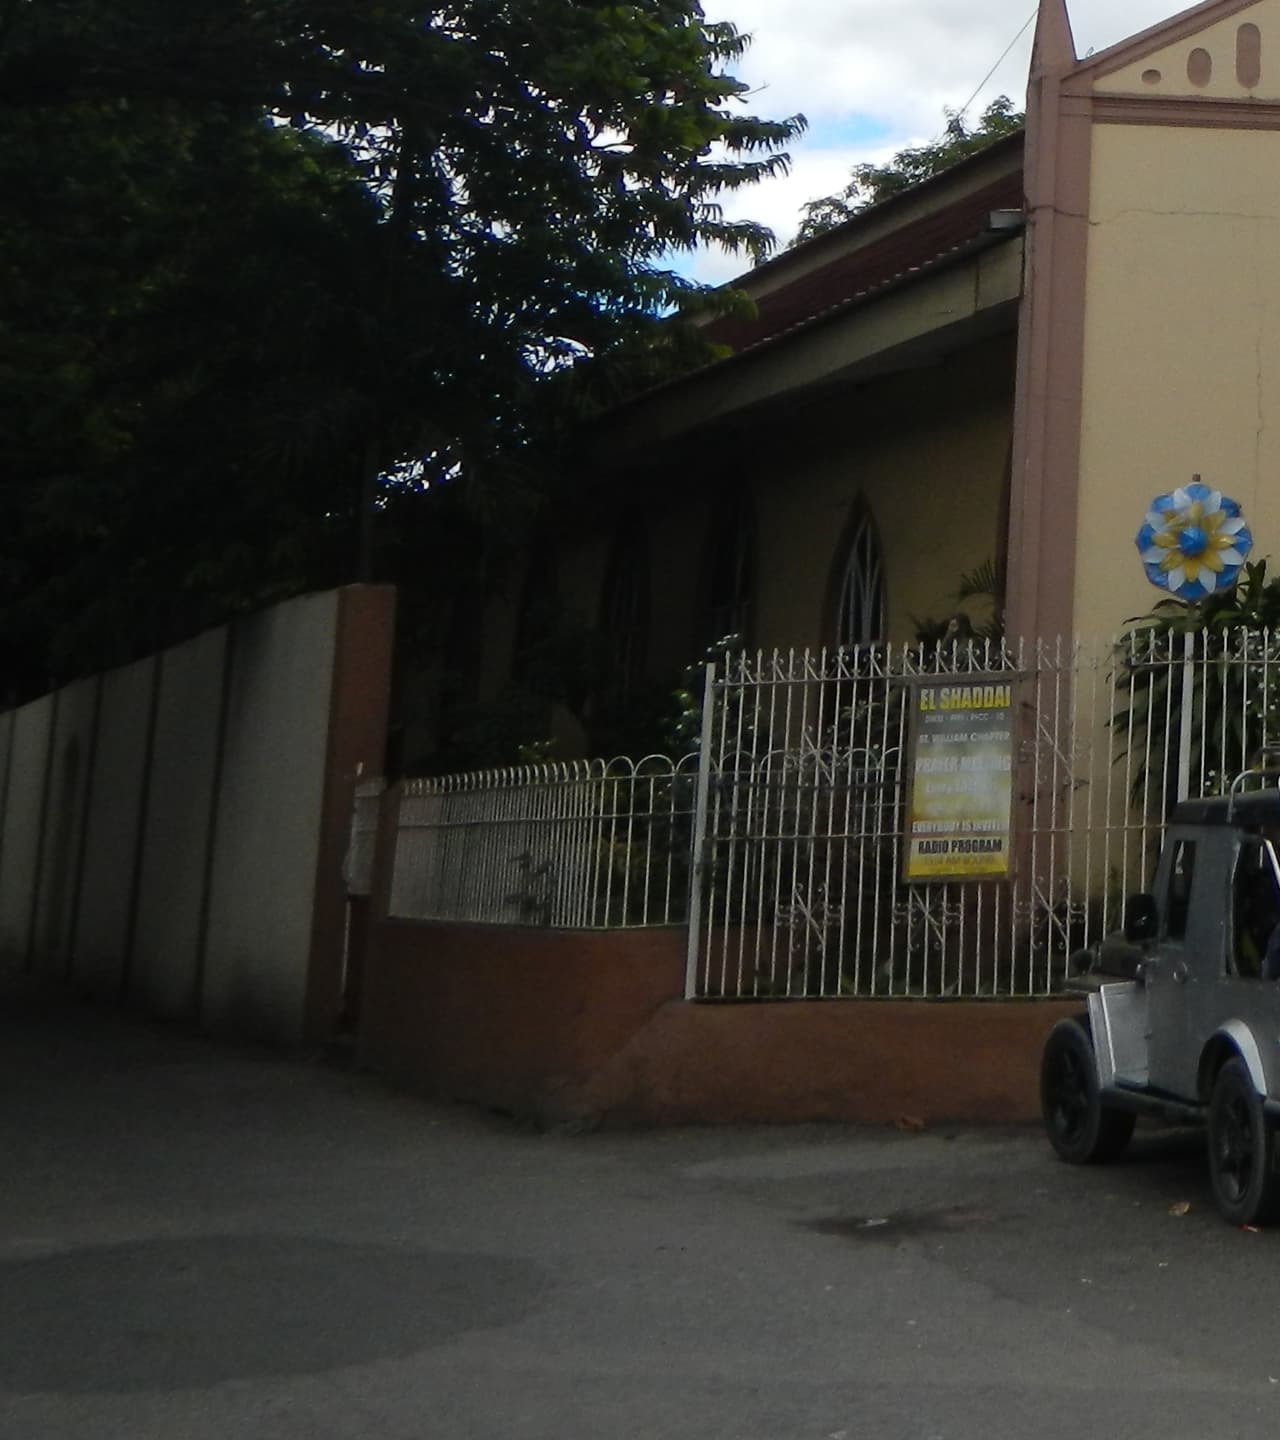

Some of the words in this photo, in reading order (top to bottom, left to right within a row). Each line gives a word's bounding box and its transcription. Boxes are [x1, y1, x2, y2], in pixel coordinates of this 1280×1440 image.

[919, 688, 937, 711] EL
[939, 685, 1012, 710] SHADDAI
[918, 841, 949, 854] RADIO
[951, 839, 1002, 854] PROGRAM
